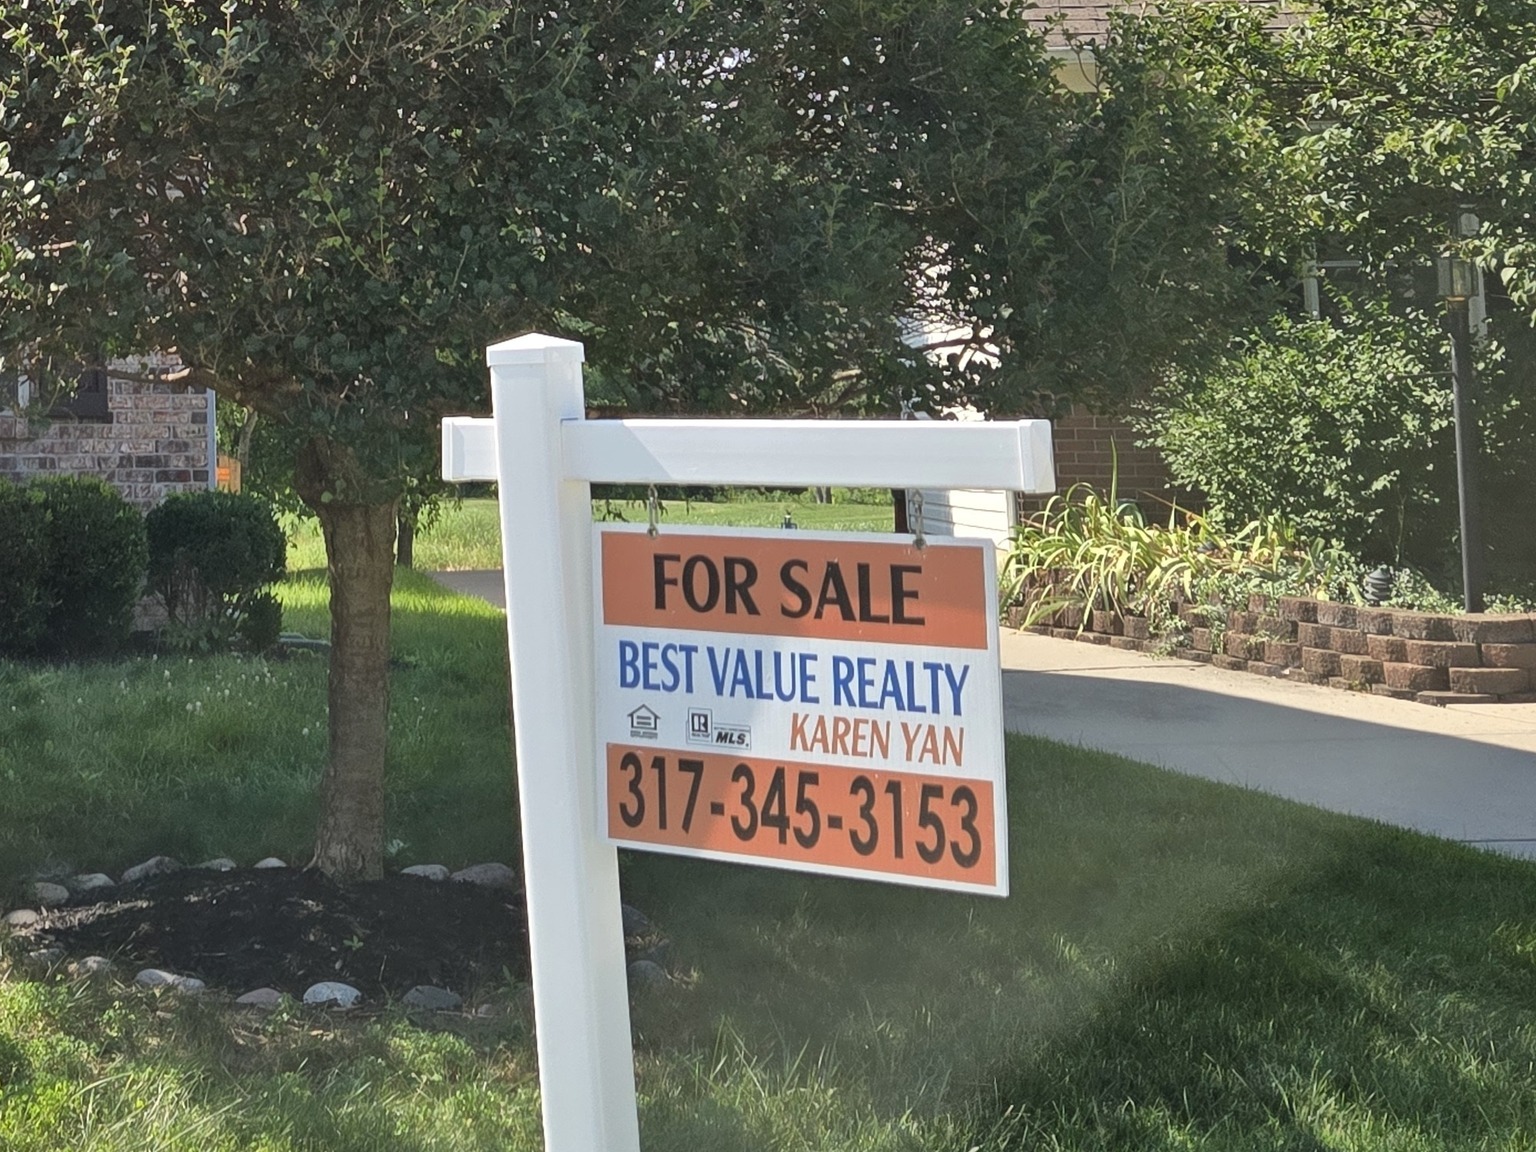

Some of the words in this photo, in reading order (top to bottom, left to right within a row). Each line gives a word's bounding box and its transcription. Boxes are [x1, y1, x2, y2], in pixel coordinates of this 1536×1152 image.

[653, 553, 761, 616] FOR
[780, 558, 925, 626] SALE
[618, 639, 698, 694] BEST
[706, 645, 820, 704] VALUE
[832, 655, 970, 716] REALTY
[789, 712, 891, 759] KAREN
[900, 721, 965, 766] YAN
[619, 751, 982, 869] 317-345-3153
